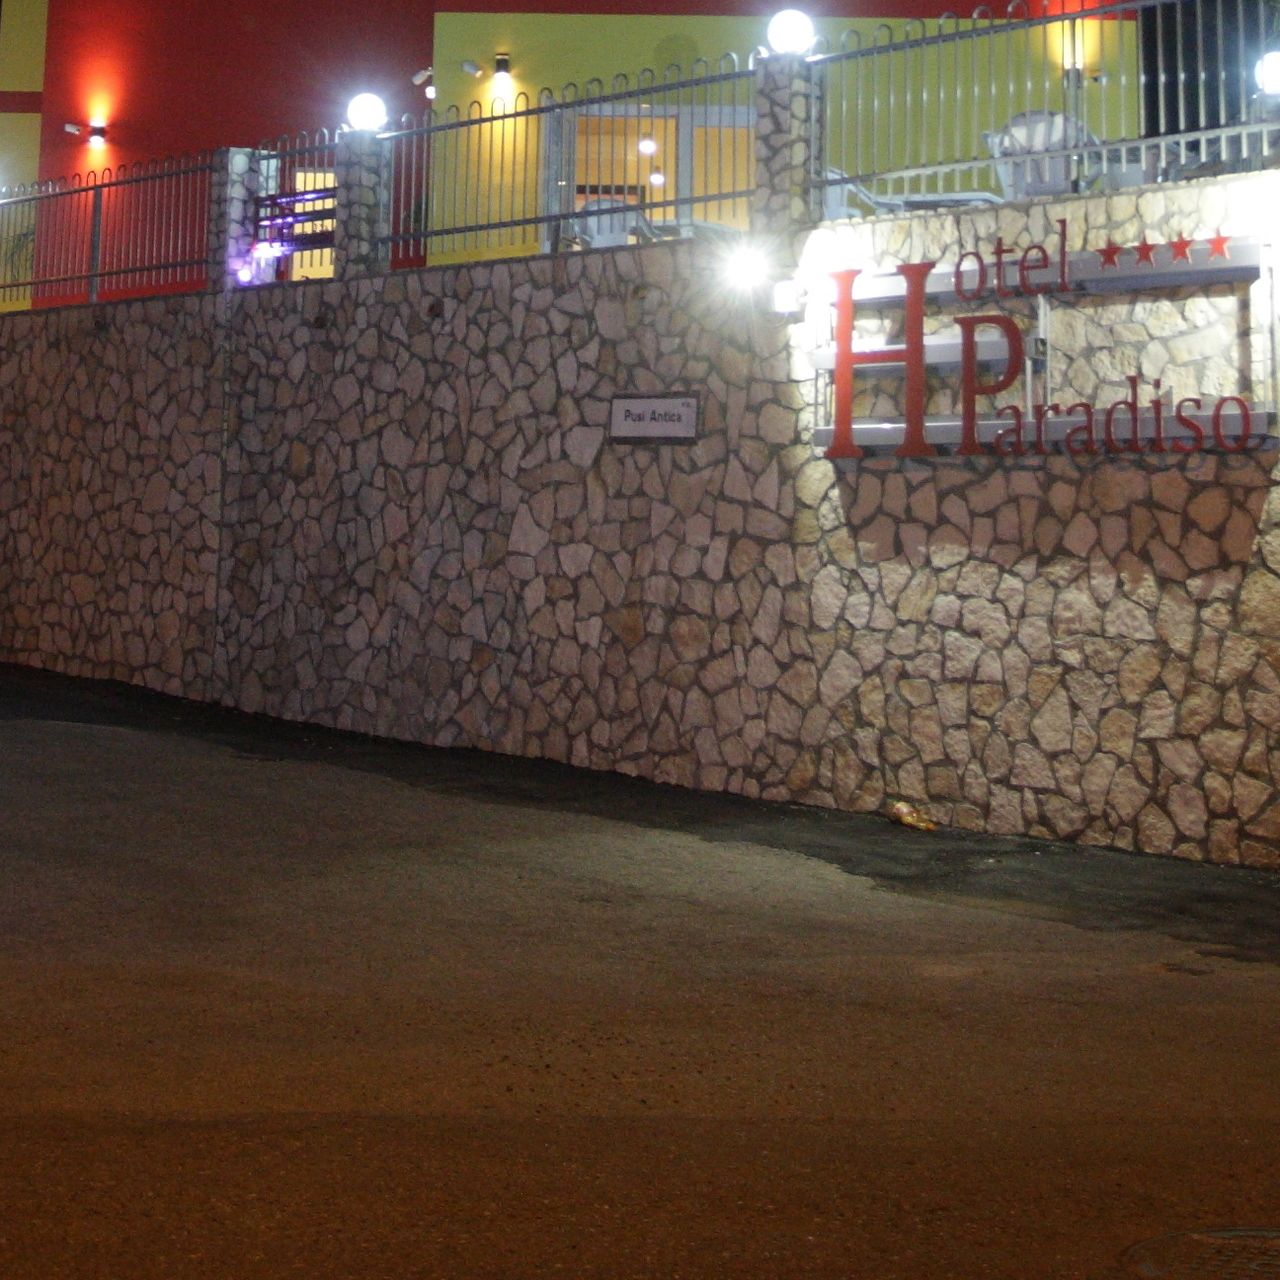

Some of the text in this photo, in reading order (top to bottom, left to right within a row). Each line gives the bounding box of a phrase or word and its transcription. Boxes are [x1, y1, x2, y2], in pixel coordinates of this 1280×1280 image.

[823, 218, 1077, 457] Hotel
[954, 314, 1252, 456] Paradiso
[649, 408, 682, 422] Antica
